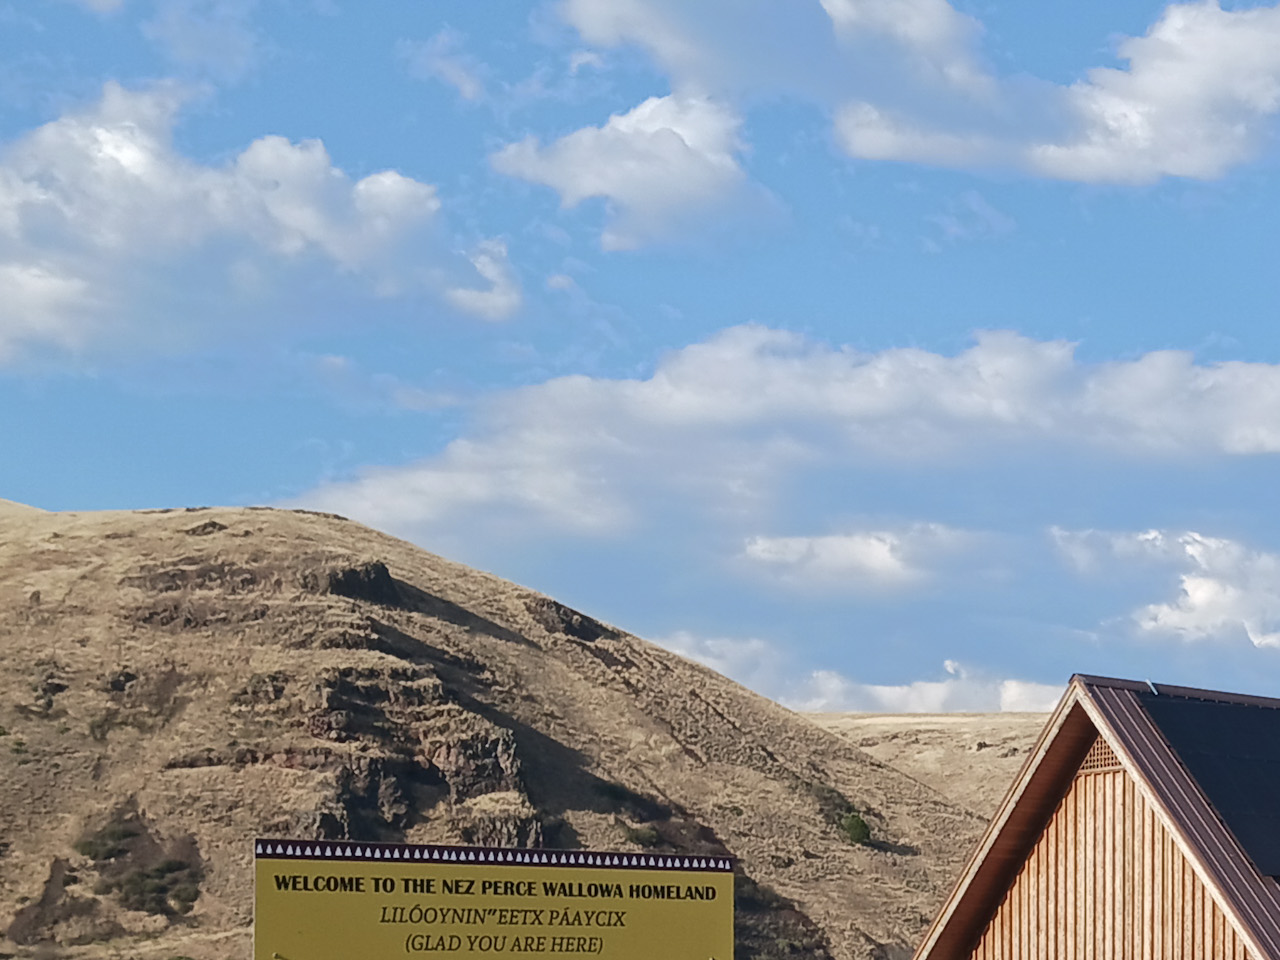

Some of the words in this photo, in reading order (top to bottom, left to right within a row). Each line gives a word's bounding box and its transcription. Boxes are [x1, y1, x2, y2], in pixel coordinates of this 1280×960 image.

[274, 875, 366, 893] WELCOME
[370, 877, 395, 893] TO
[401, 879, 436, 894] THE
[442, 880, 475, 895] NEZ
[481, 879, 537, 897] PERCE
[542, 882, 623, 898] WALLOWA
[629, 885, 716, 900] HOMELAND
[548, 907, 626, 927] PÁAYCIX
[406, 934, 461, 953] (GLAD
[466, 934, 506, 952] YOU
[510, 936, 546, 952] ARE
[551, 937, 603, 954] HERE)
